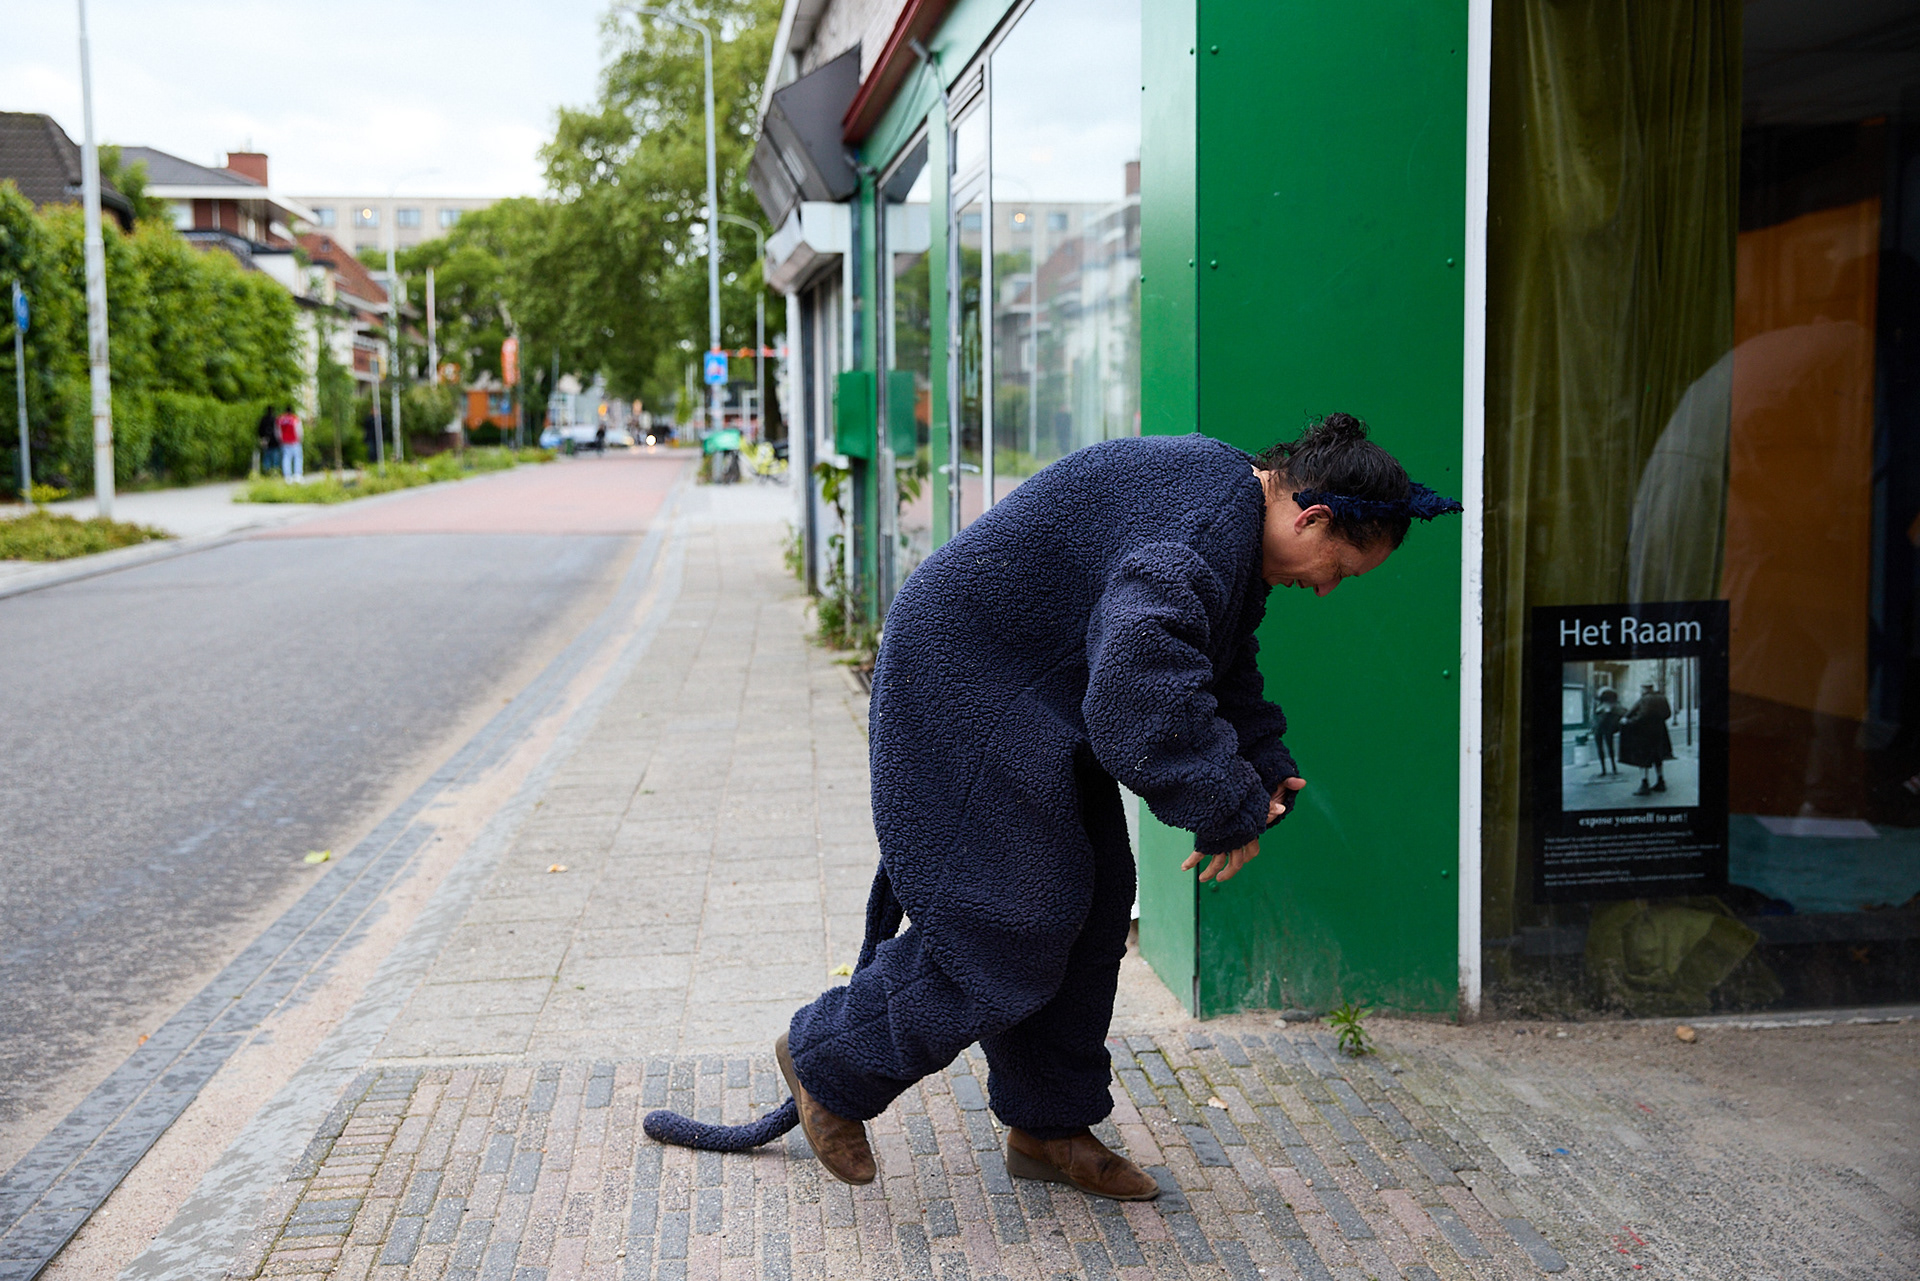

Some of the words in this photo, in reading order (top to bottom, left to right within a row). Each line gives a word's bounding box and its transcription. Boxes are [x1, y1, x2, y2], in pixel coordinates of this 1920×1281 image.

[1560, 618, 1611, 647] Het
[1620, 616, 1702, 645] Raam
[1579, 816, 1613, 829] expose
[1656, 813, 1667, 824] to
